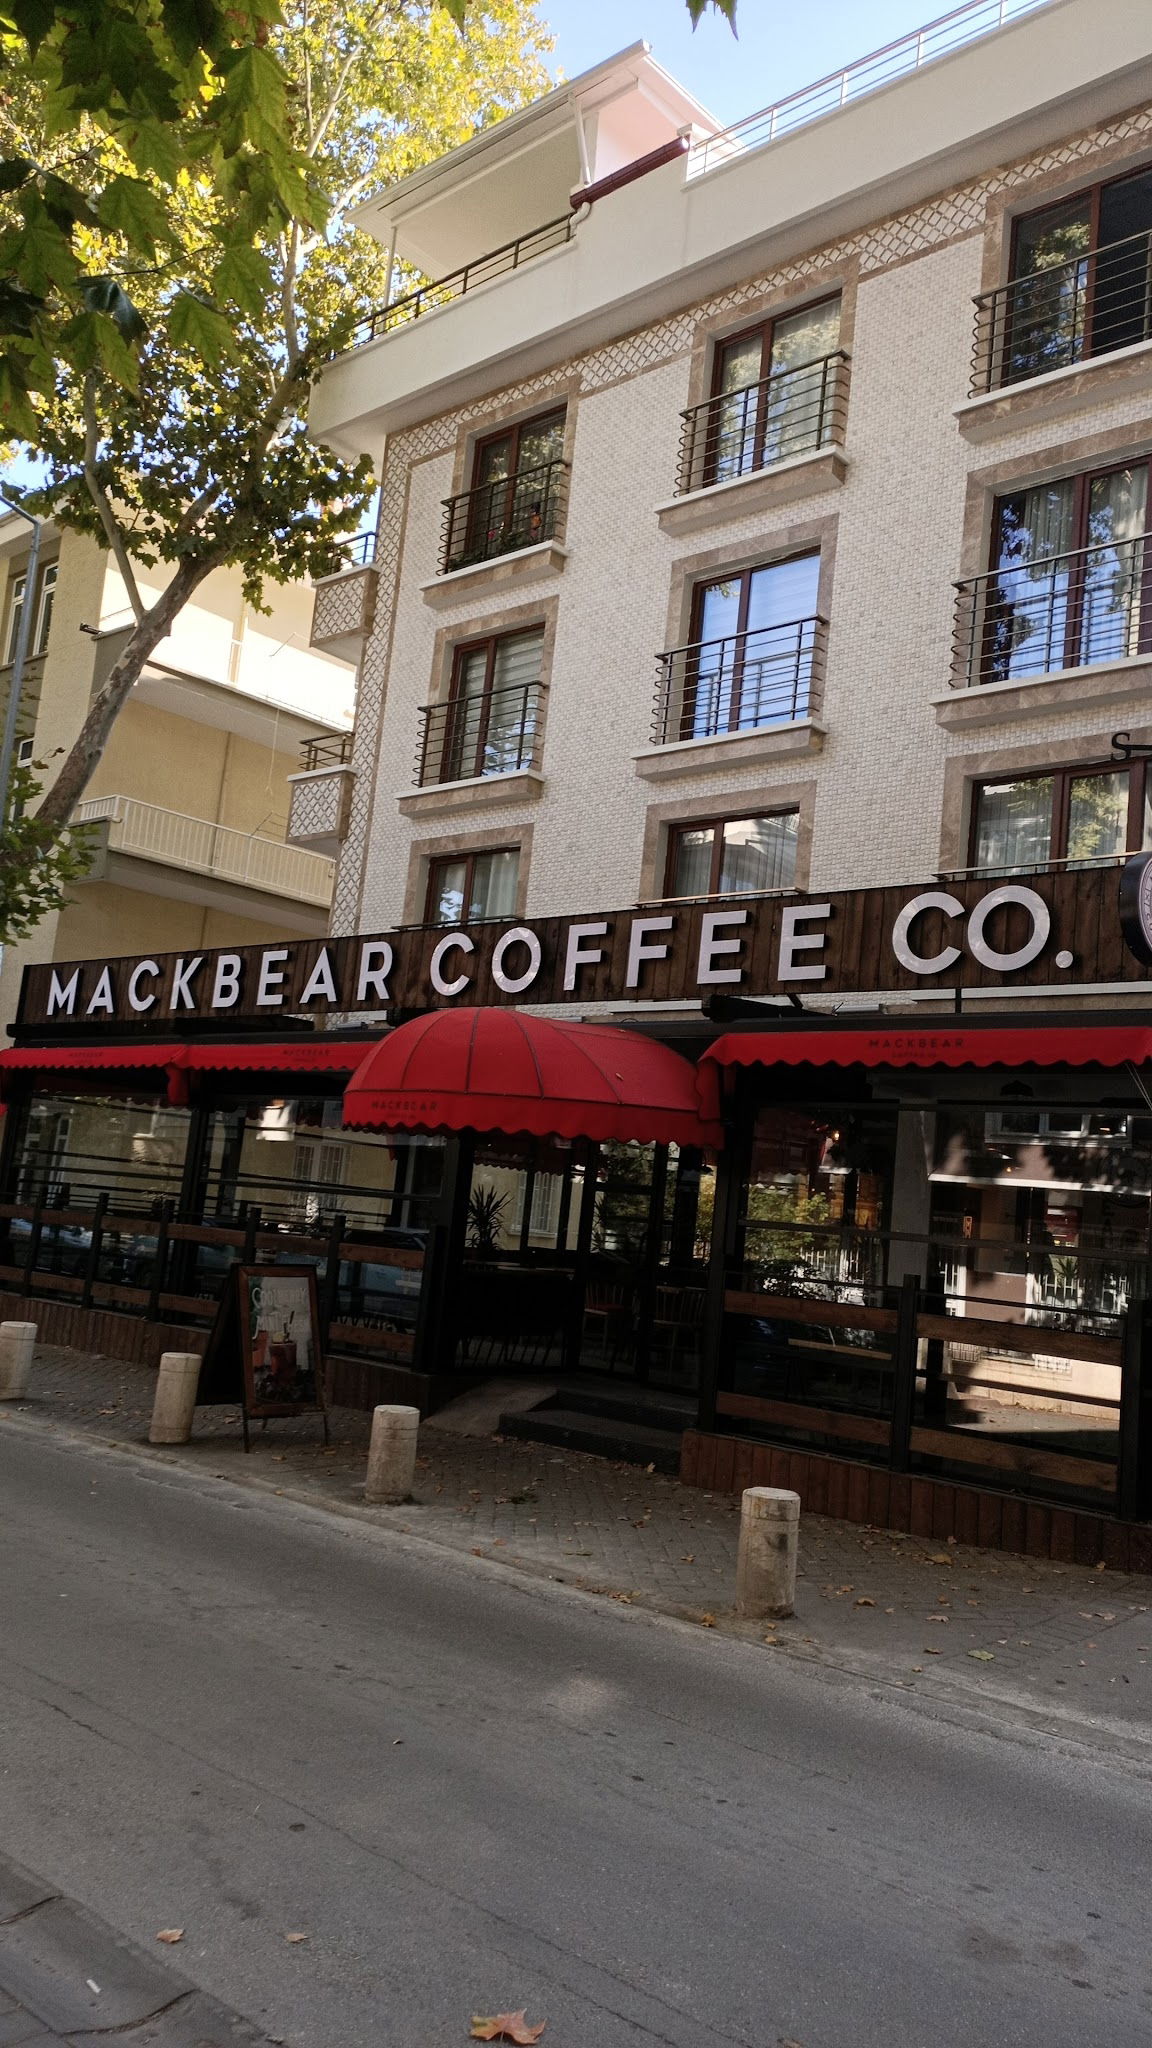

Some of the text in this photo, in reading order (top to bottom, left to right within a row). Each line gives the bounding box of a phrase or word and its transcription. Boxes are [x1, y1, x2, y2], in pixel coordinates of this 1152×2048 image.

[45, 940, 395, 1017] MACKBEAR
[430, 902, 832, 996] COFFEE
[891, 884, 1075, 975] CO.
[869, 1037, 965, 1049] MACKBEAR
